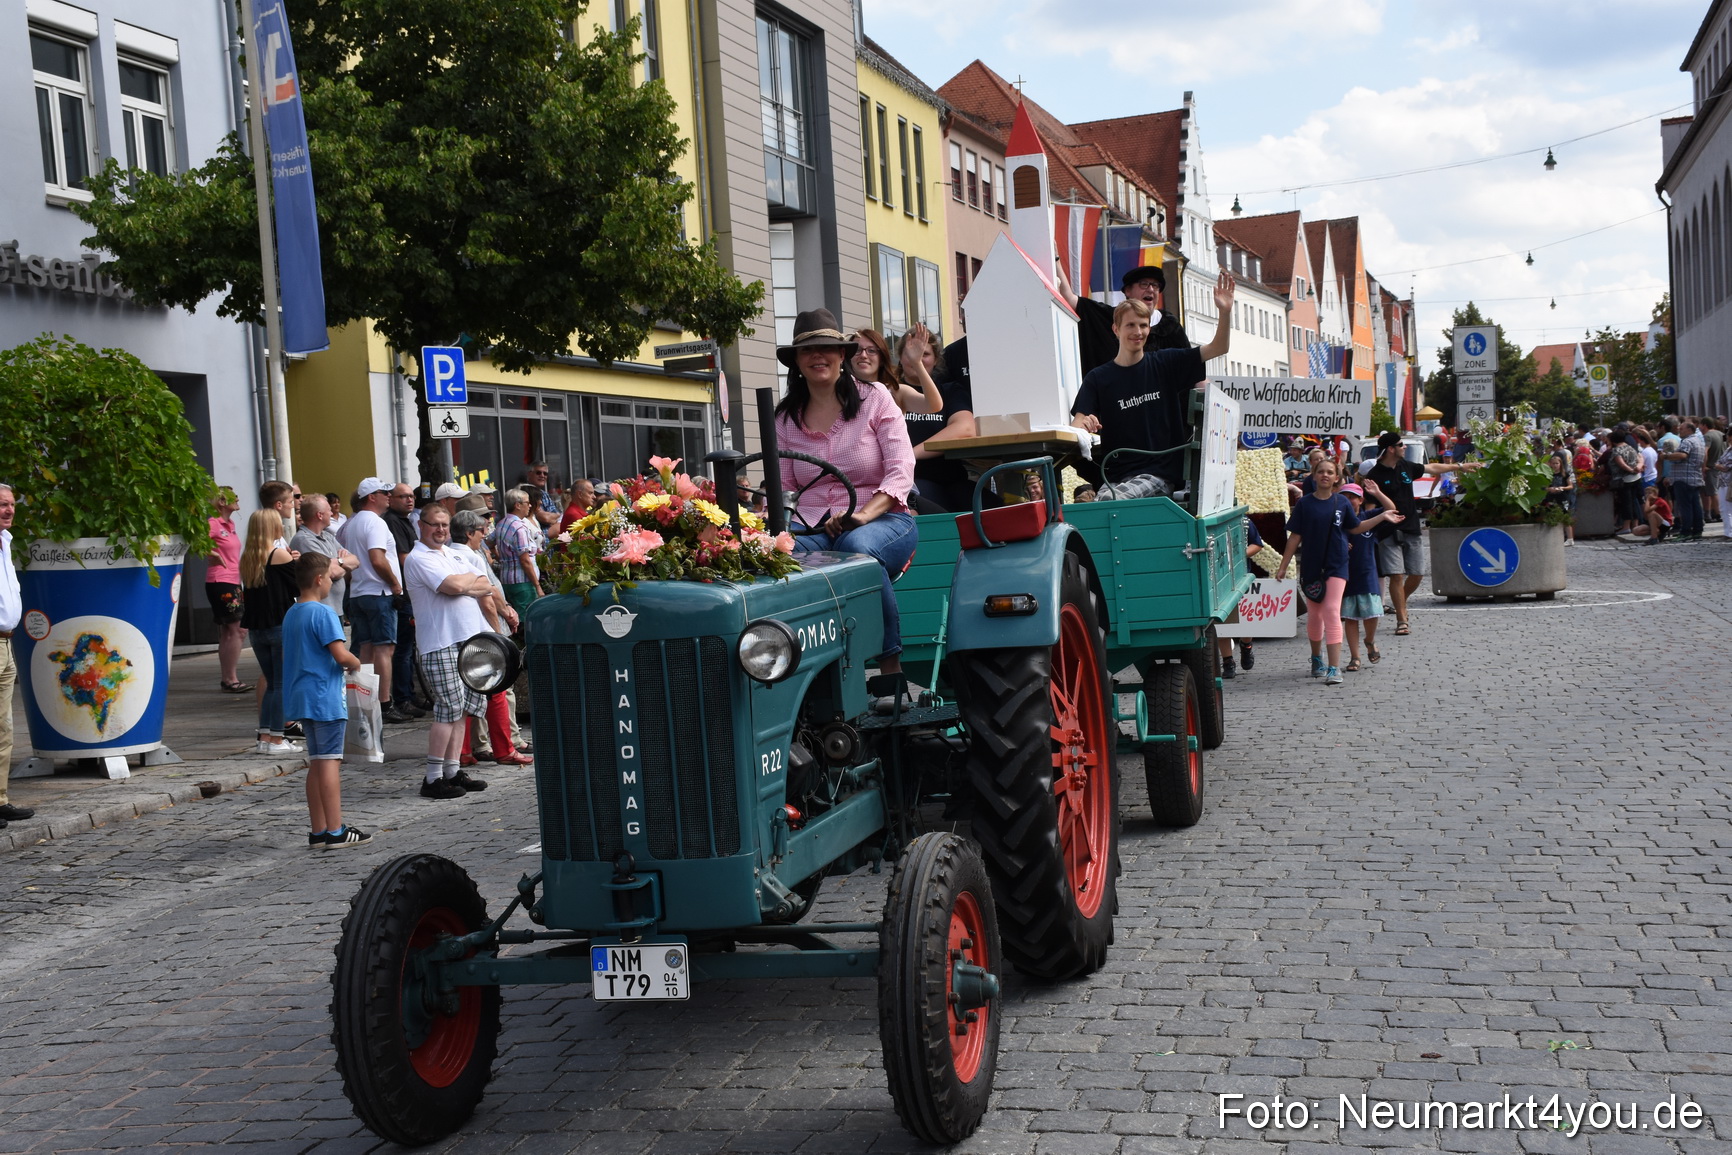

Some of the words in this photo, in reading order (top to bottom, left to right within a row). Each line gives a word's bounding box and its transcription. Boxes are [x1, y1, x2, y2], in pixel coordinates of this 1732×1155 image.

[655, 343, 712, 356] Brunnwirtsgasse
[1465, 360, 1487, 368] ZONE
[433, 354, 455, 396] P
[1459, 377, 1492, 385] Lieferverkehr
[1117, 391, 1160, 410] Lutheraner
[1253, 381, 1325, 405] Woffabecka
[1328, 384, 1361, 404] Kirch
[904, 412, 943, 423] utheraner
[1243, 409, 1302, 429] machen's
[1305, 411, 1353, 432] möglich
[797, 618, 836, 652] OMAG
[615, 669, 640, 835] HANOMAG
[597, 961, 604, 970] D
[611, 949, 642, 972] NM
[663, 972, 678, 983] 04
[665, 986, 678, 997] 10
